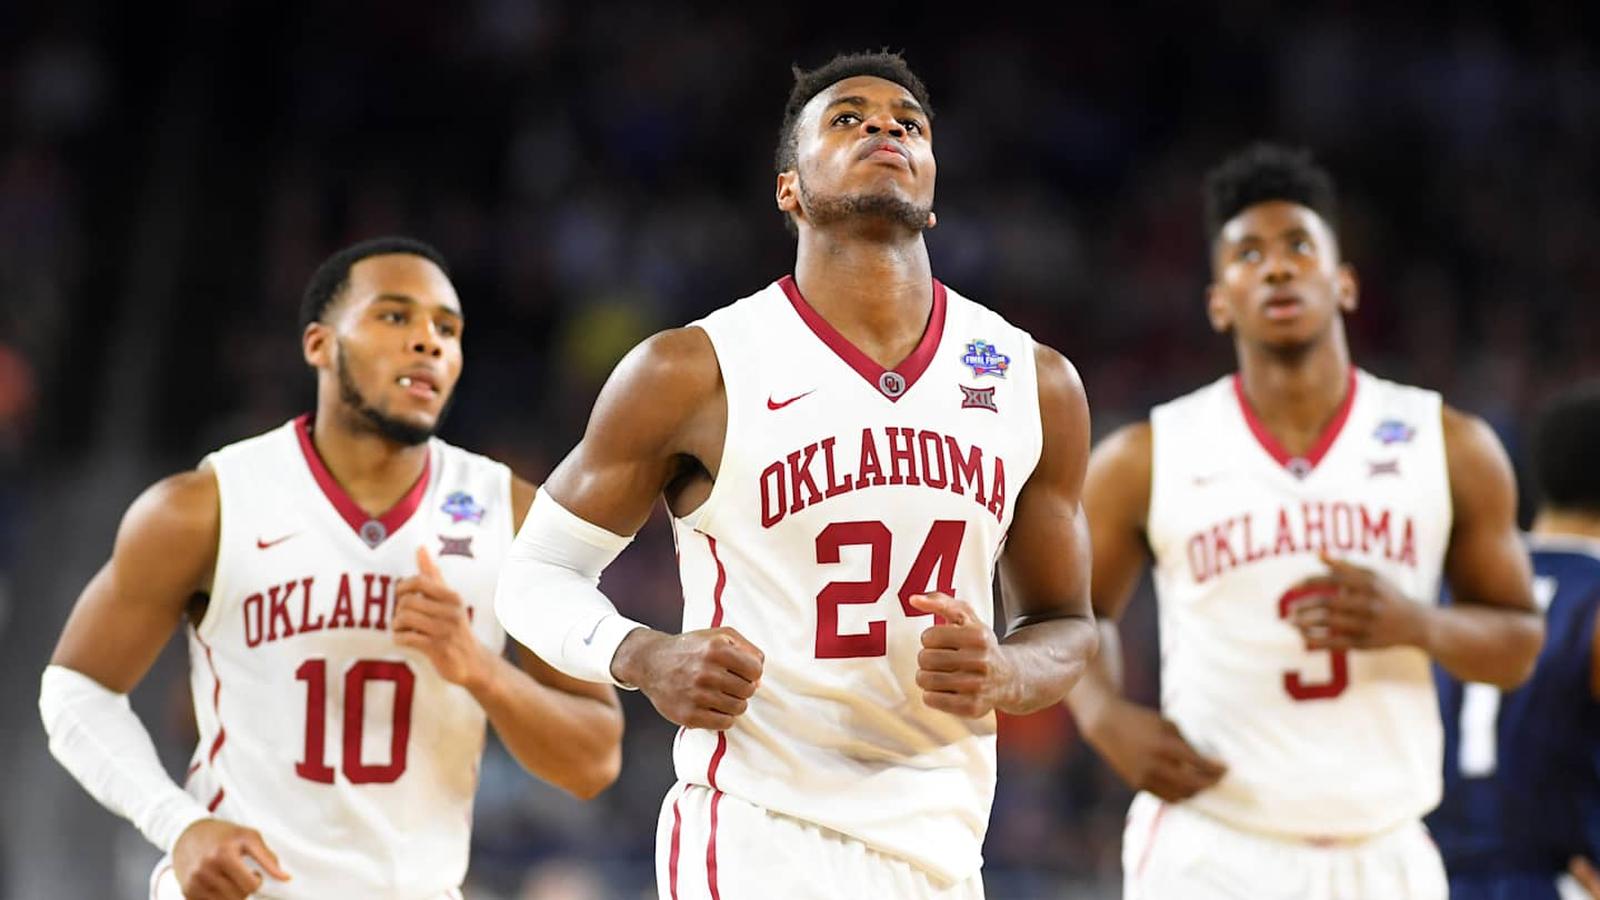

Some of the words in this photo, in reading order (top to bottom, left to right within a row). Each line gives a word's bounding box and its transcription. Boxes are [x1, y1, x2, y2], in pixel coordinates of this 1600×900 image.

[884, 376, 900, 393] OU
[760, 427, 1005, 528] OKLAHOMA
[1187, 500, 1417, 584] OKLAHOMA
[243, 573, 474, 648] OKLAH
[815, 520, 966, 658] 24
[296, 659, 415, 785] 10
